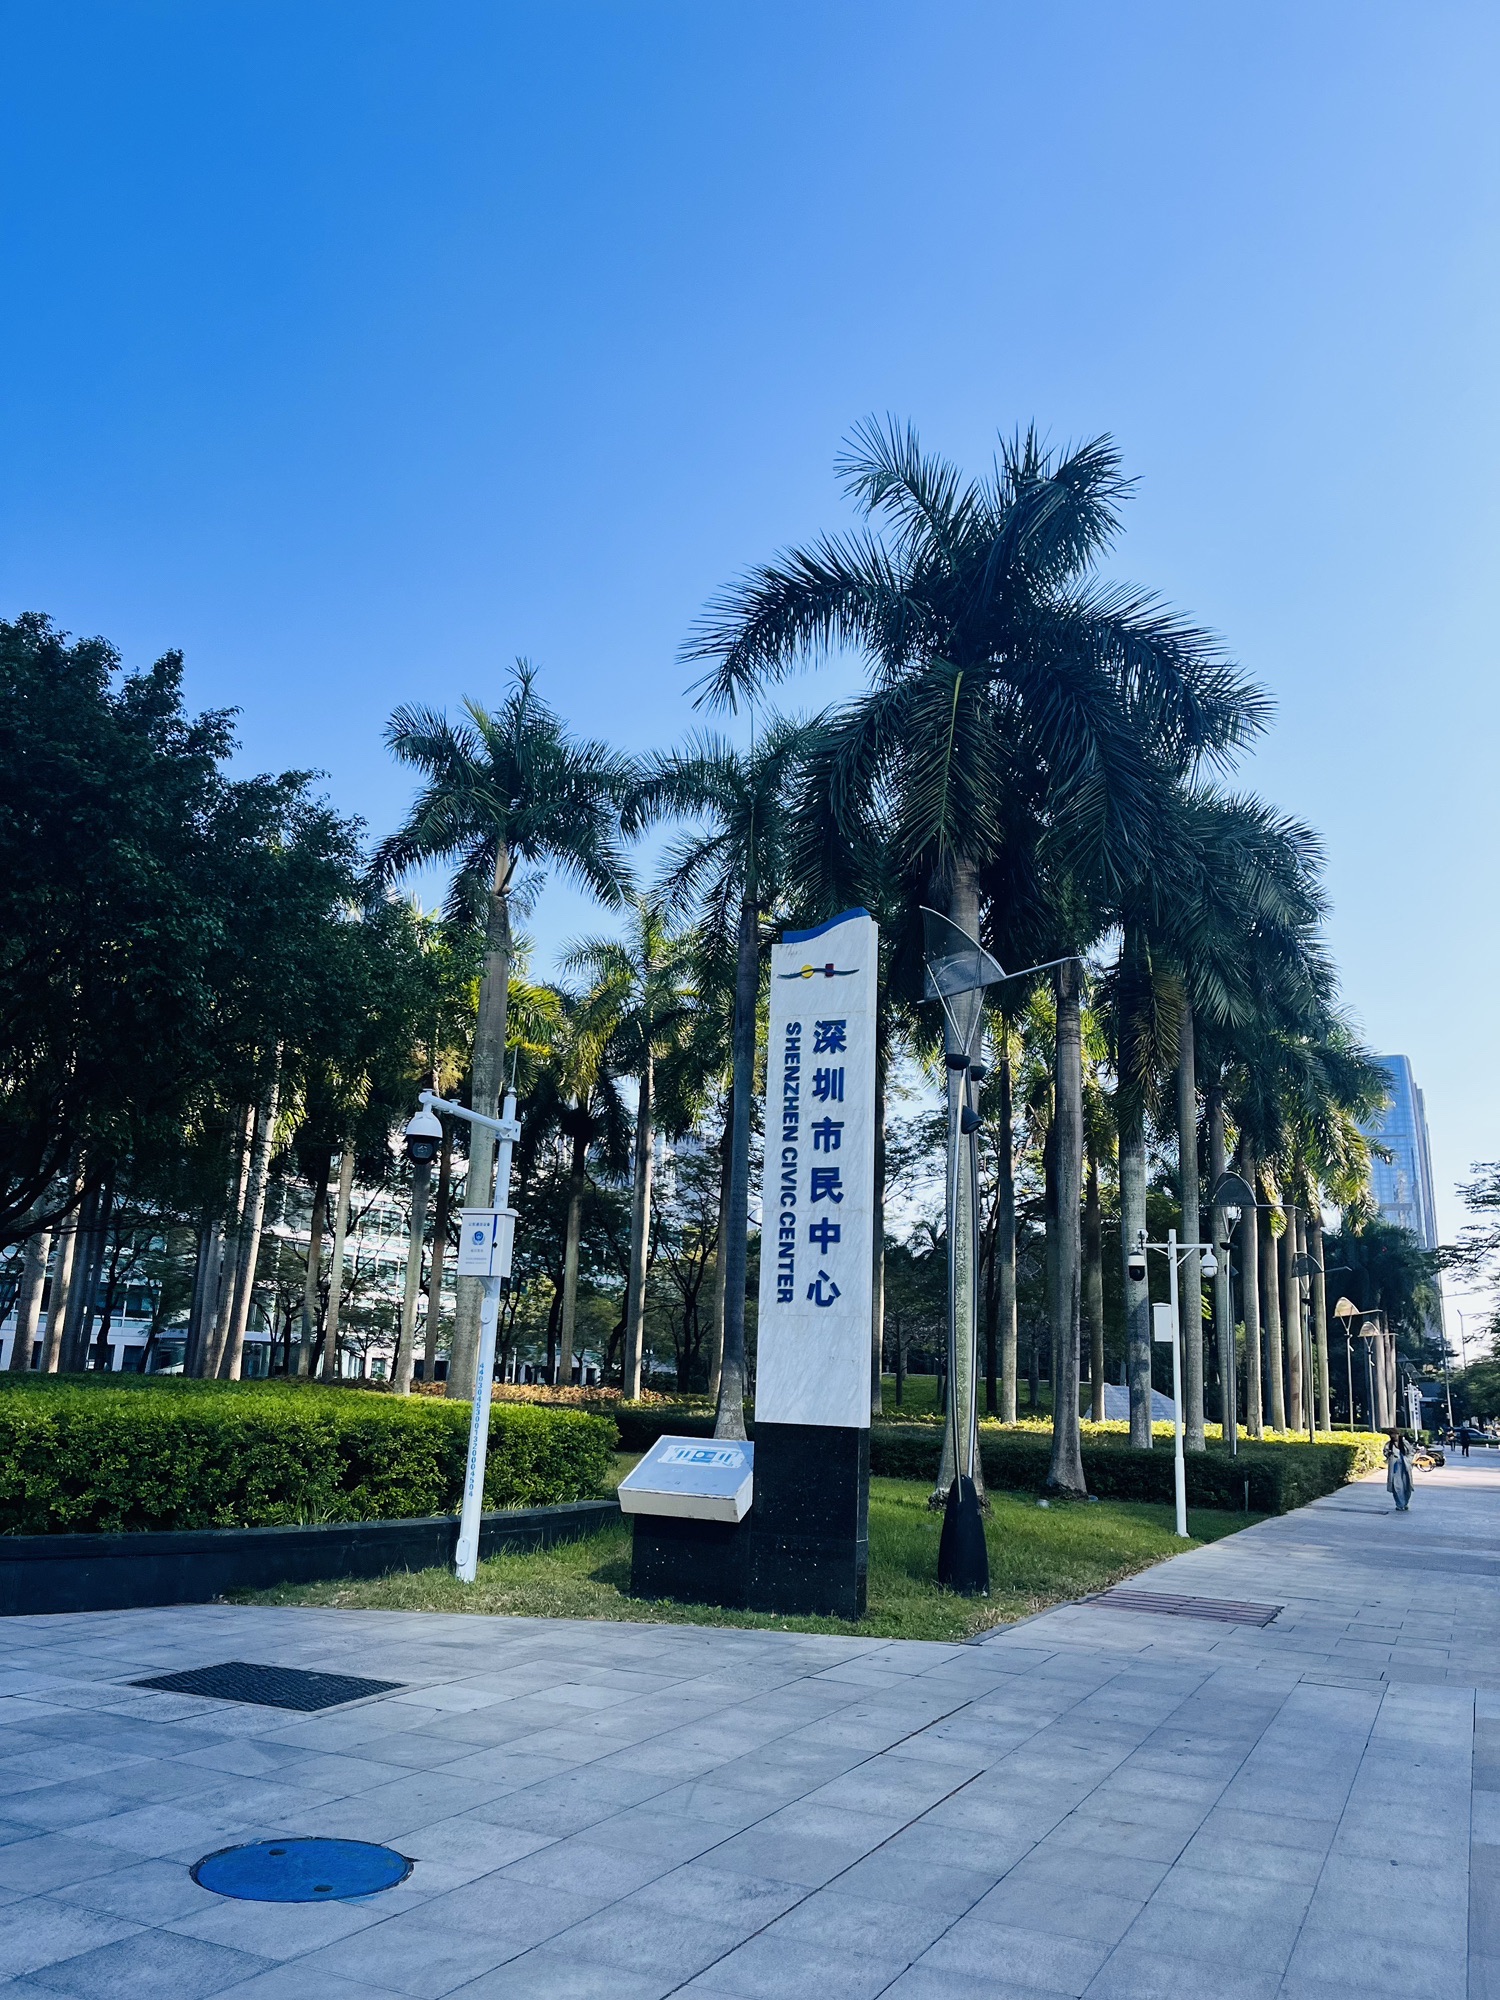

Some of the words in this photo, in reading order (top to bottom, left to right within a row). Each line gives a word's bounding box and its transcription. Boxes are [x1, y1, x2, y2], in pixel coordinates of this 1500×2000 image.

[782, 1021, 802, 1142] SHENZHEN
[780, 1146, 798, 1207] CIVIC
[806, 1019, 847, 1307] 深圳市民中心
[777, 1211, 796, 1304] CENTER
